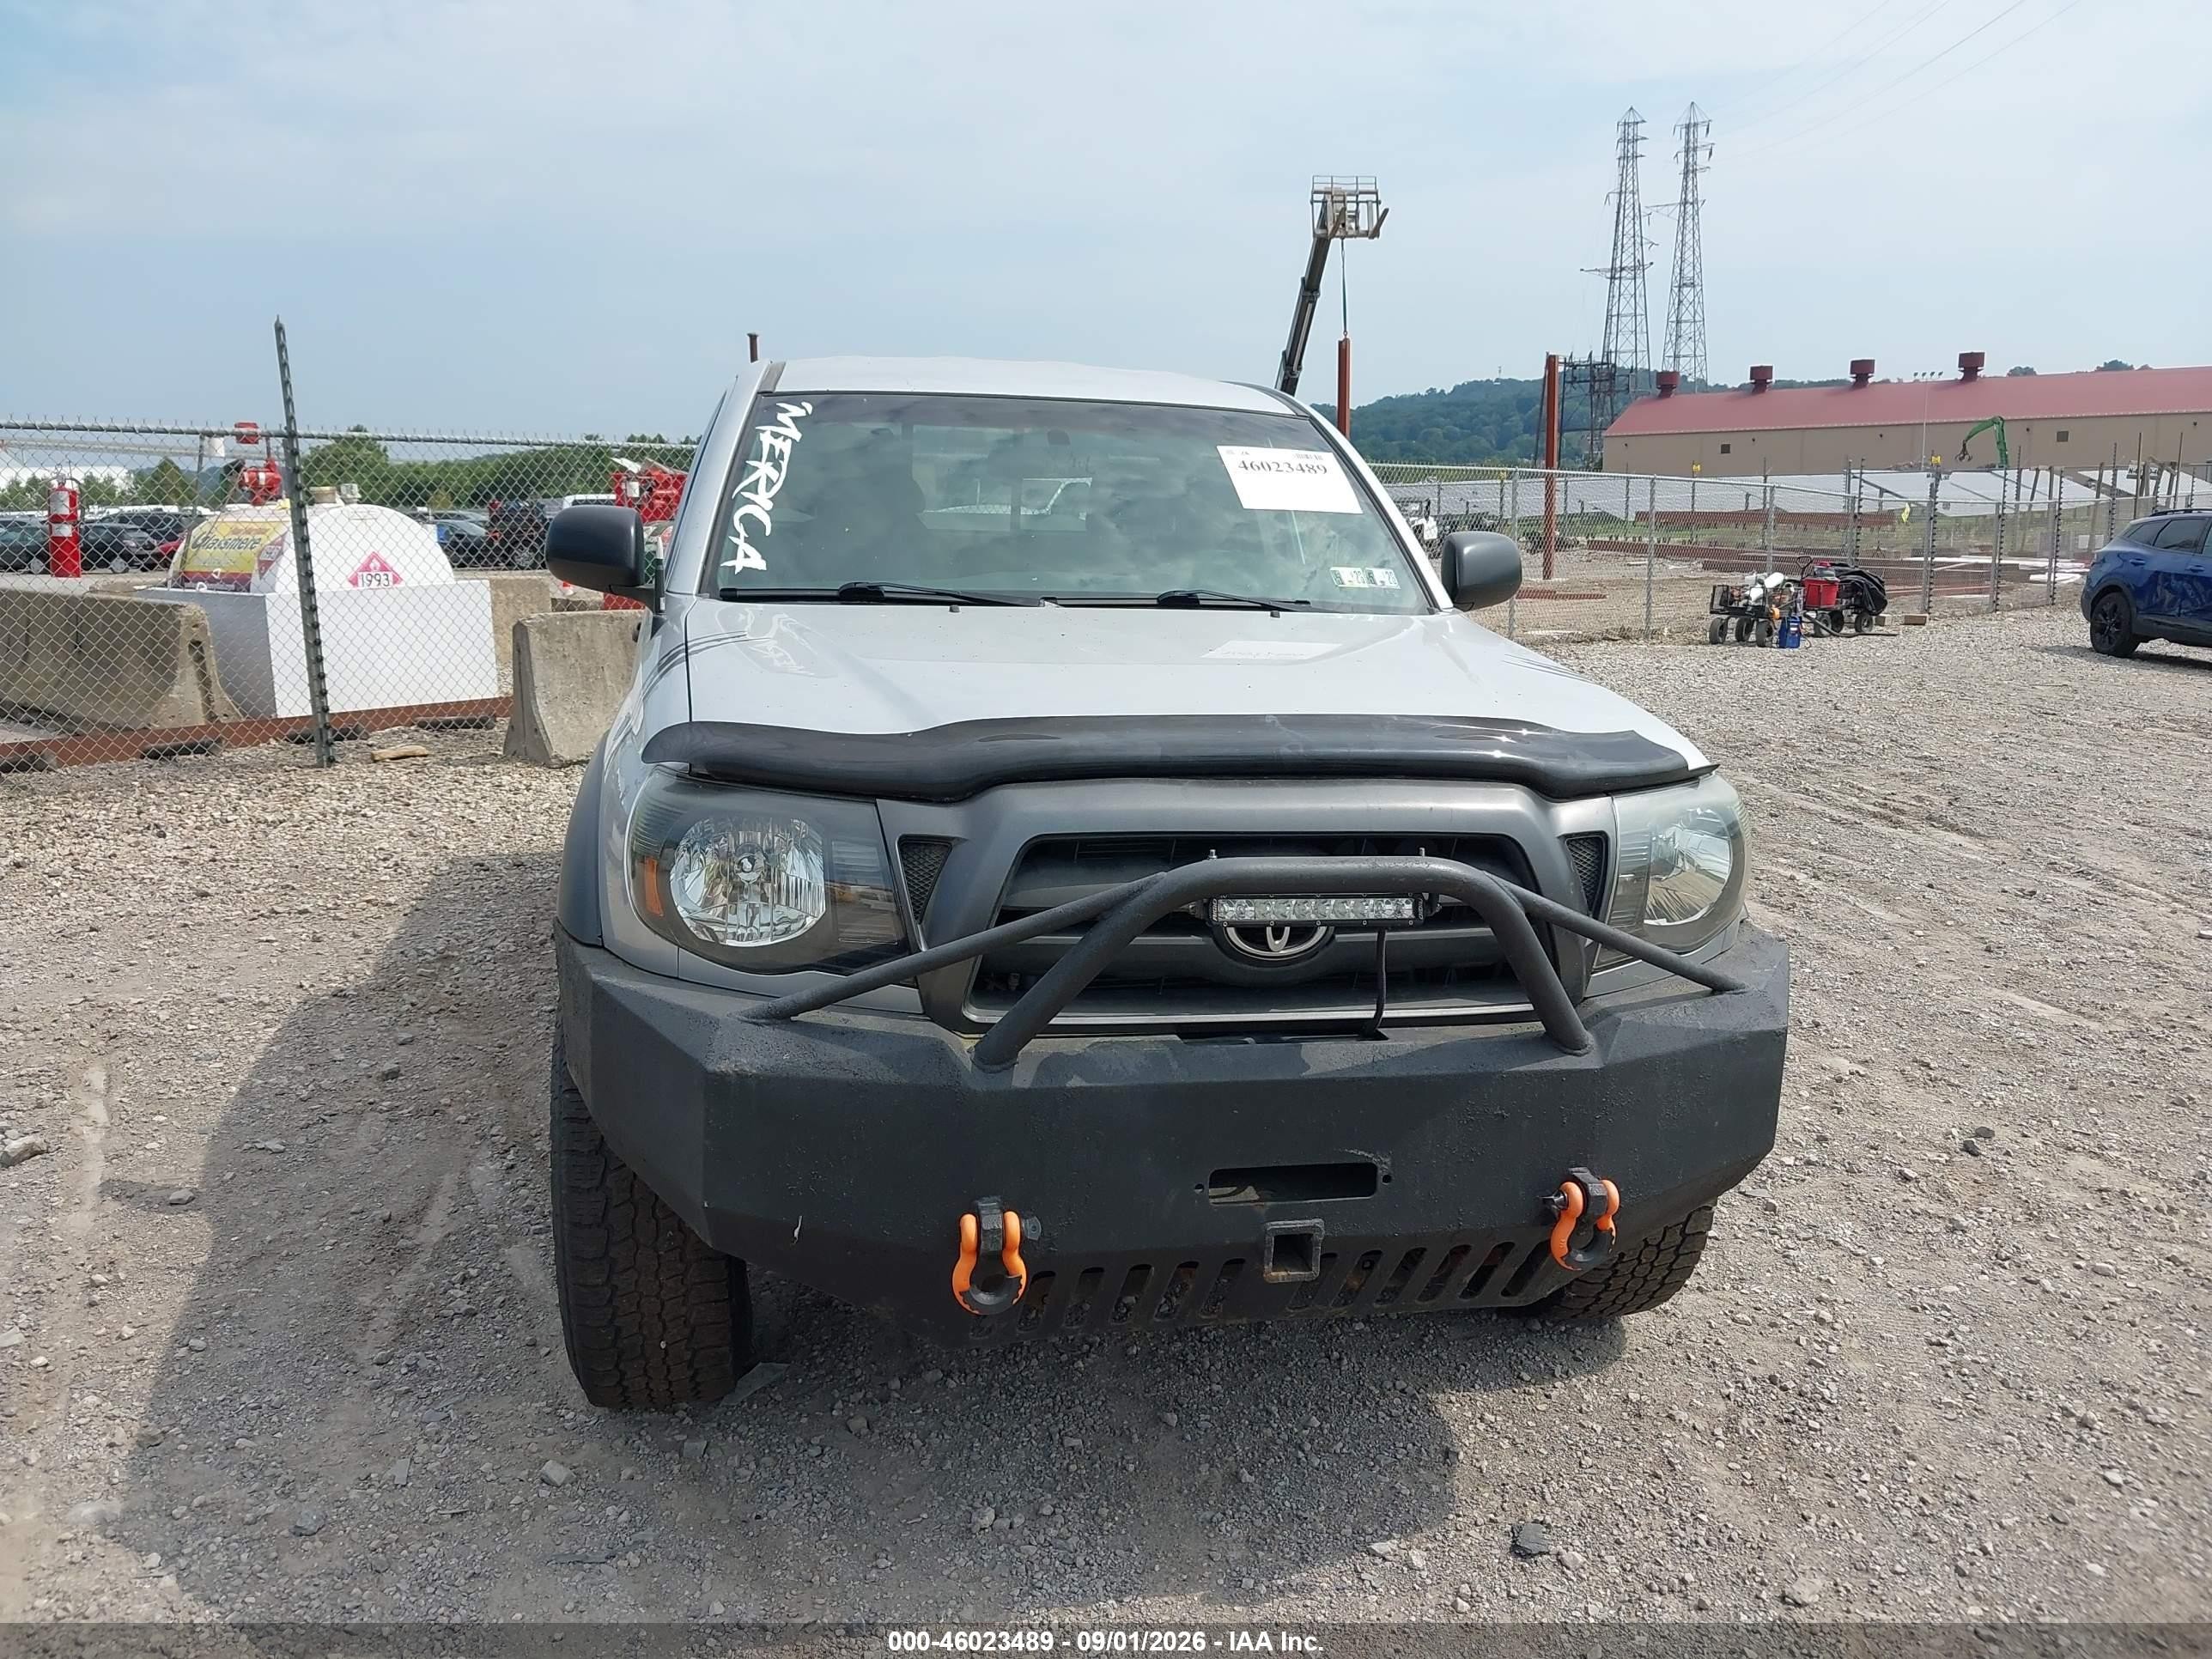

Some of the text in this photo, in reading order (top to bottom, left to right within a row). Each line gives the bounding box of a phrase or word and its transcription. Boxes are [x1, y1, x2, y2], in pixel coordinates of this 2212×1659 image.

[1237, 459, 1328, 475] 46023489
[720, 401, 813, 575] 'MERICA
[361, 573, 390, 587] 1993
